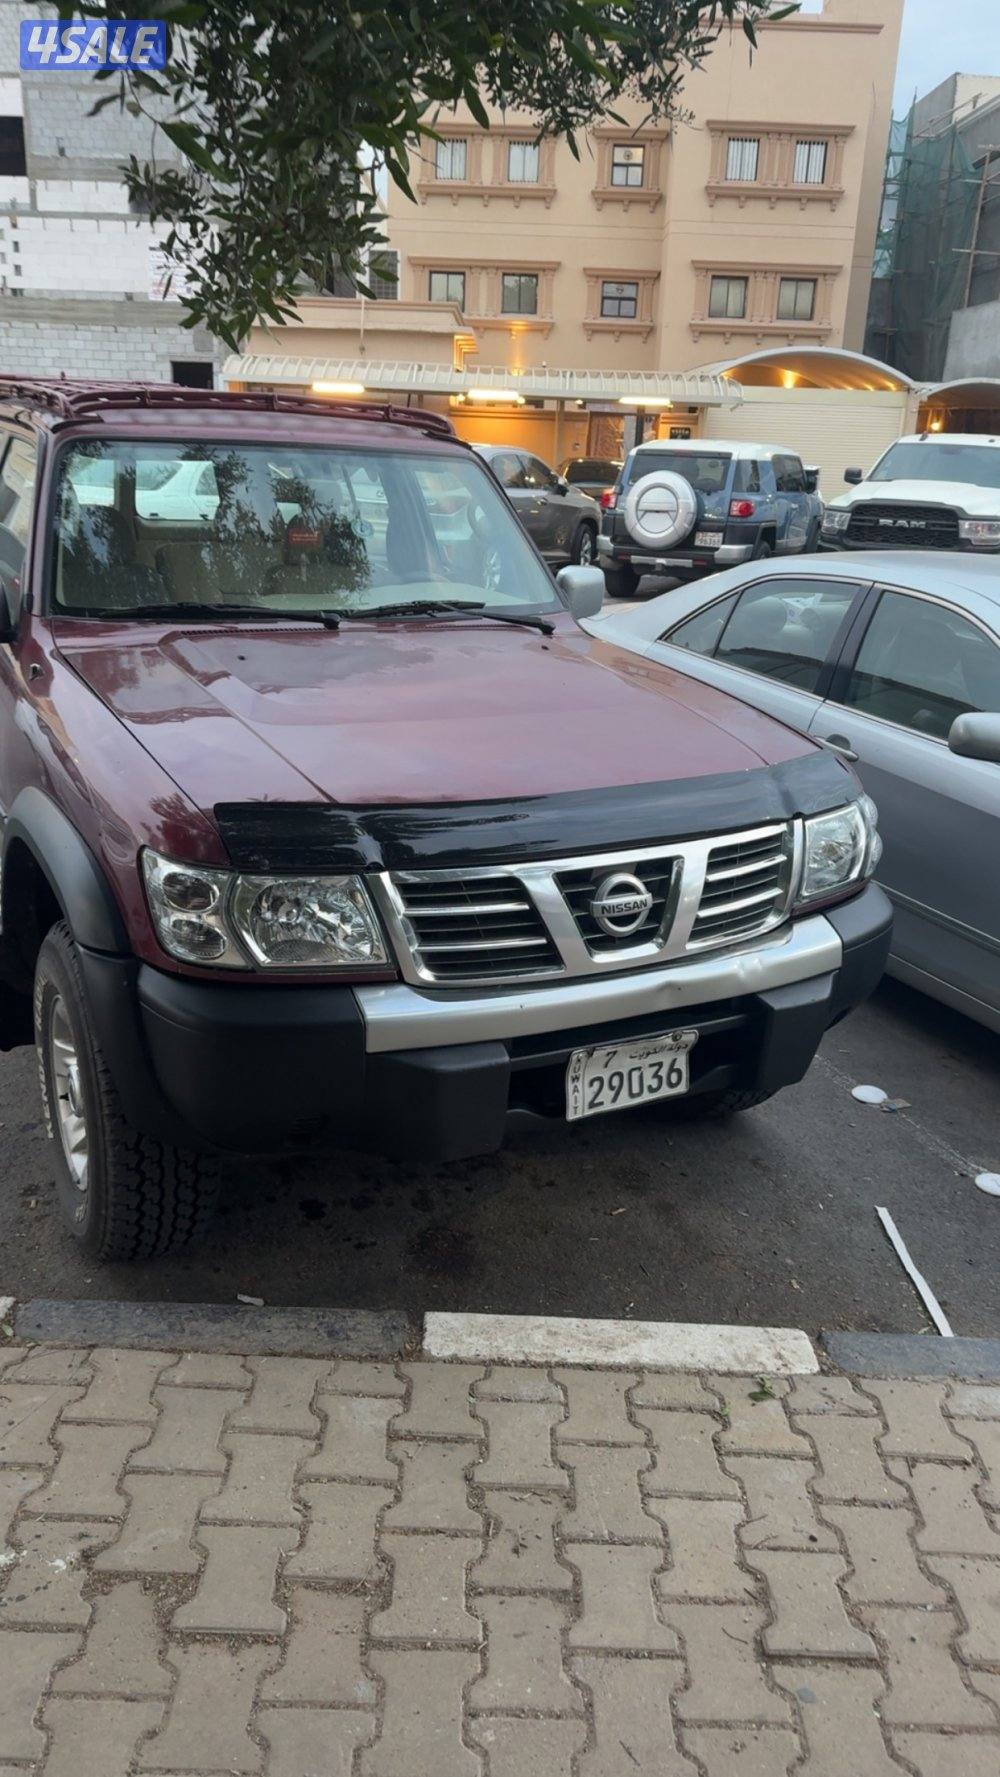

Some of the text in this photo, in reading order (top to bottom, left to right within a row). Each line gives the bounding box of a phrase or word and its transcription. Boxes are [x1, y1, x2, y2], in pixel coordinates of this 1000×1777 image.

[878, 518, 926, 529] RAM
[601, 898, 648, 915] NISSAN
[604, 1049, 618, 1068] 7
[571, 1054, 582, 1115] KUWAIT
[587, 1057, 683, 1110] 29036
